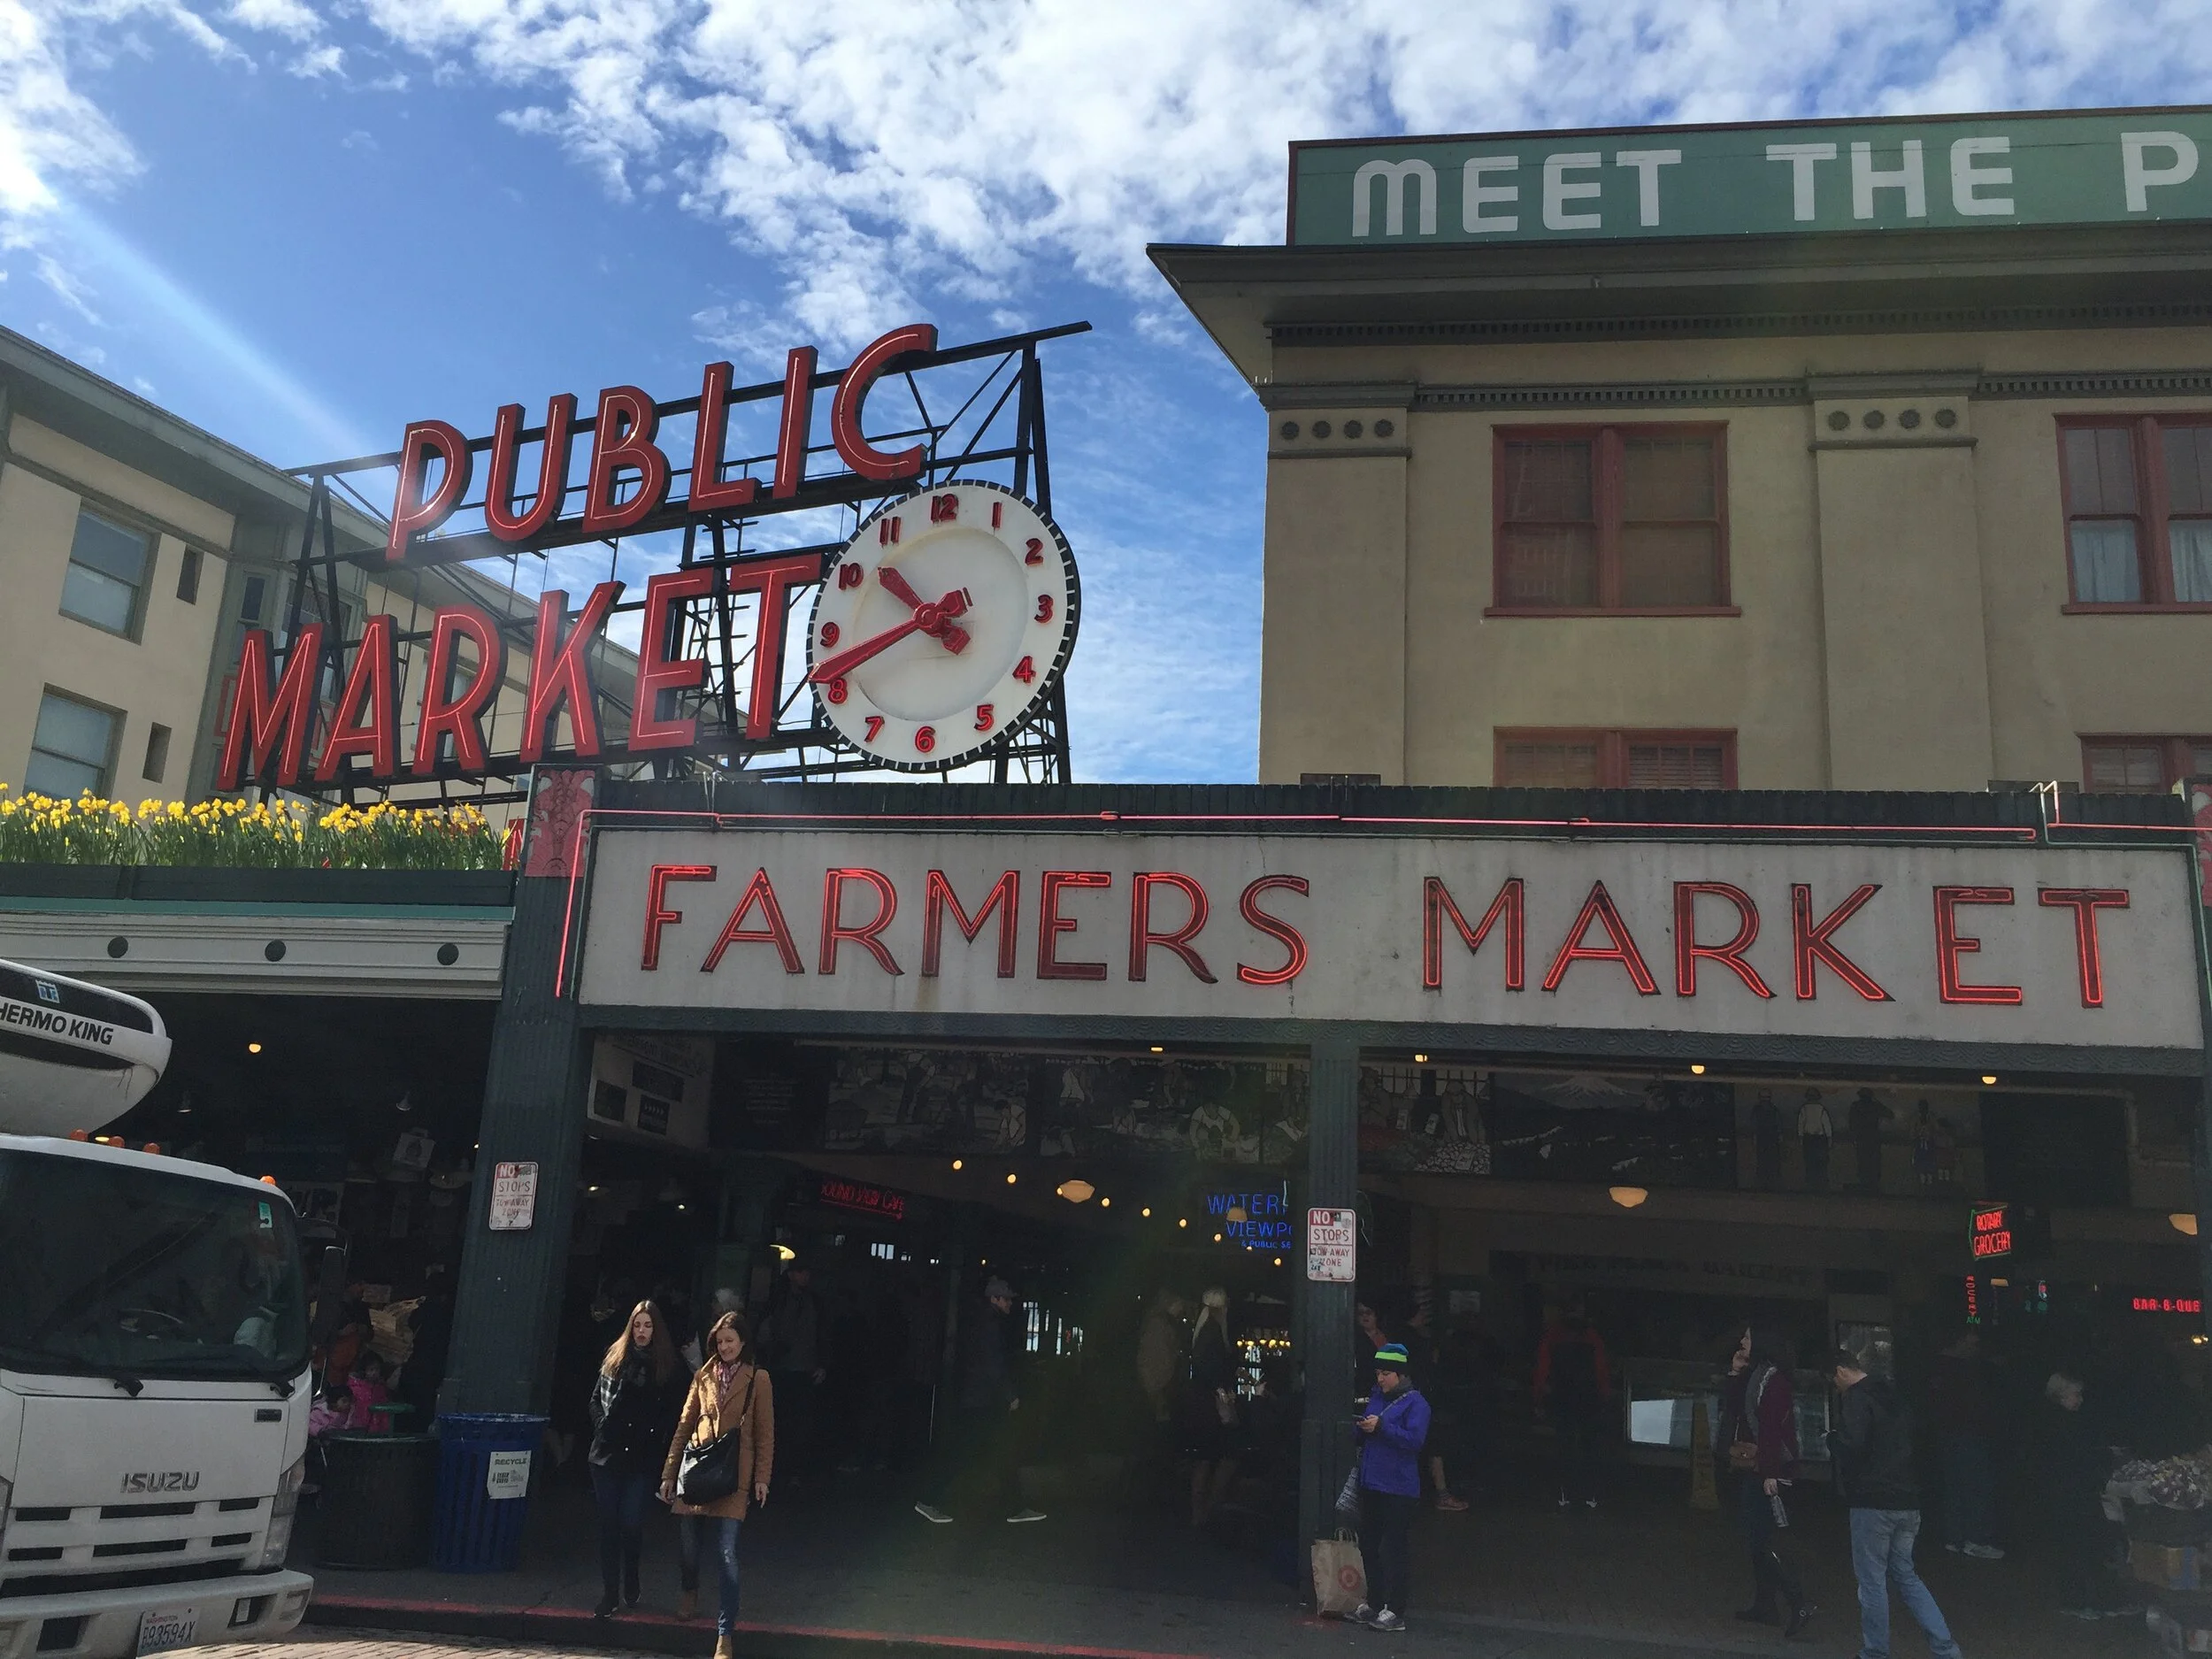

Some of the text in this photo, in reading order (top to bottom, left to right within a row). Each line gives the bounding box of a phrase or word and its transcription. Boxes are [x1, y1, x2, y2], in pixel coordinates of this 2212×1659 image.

[1352, 131, 2200, 237] MEET THE P
[386, 323, 938, 561] PUBLIC
[931, 493, 959, 522] 12
[992, 502, 1002, 528] 1
[879, 516, 901, 545] 11
[1025, 538, 1043, 565] 2
[838, 562, 864, 590] 10
[1034, 595, 1054, 623] 3
[820, 622, 840, 648] 9
[216, 553, 822, 792] MARKET
[1012, 656, 1036, 683] 4
[827, 678, 849, 704] 8
[864, 716, 885, 742] 7
[973, 704, 995, 731] 5
[915, 726, 935, 753] 6
[641, 864, 2131, 1009] FARMERS MARKET
[68, 1018, 114, 1045] KING
[501, 1164, 515, 1177] NO
[499, 1181, 530, 1193] STOPS
[1313, 1210, 1331, 1225] NO
[1313, 1228, 1349, 1241] STOPS
[1974, 1231, 2011, 1256] GROCERY
[2133, 1297, 2200, 1312] BAR-B-QUE
[120, 1471, 200, 1494] ISUZU
